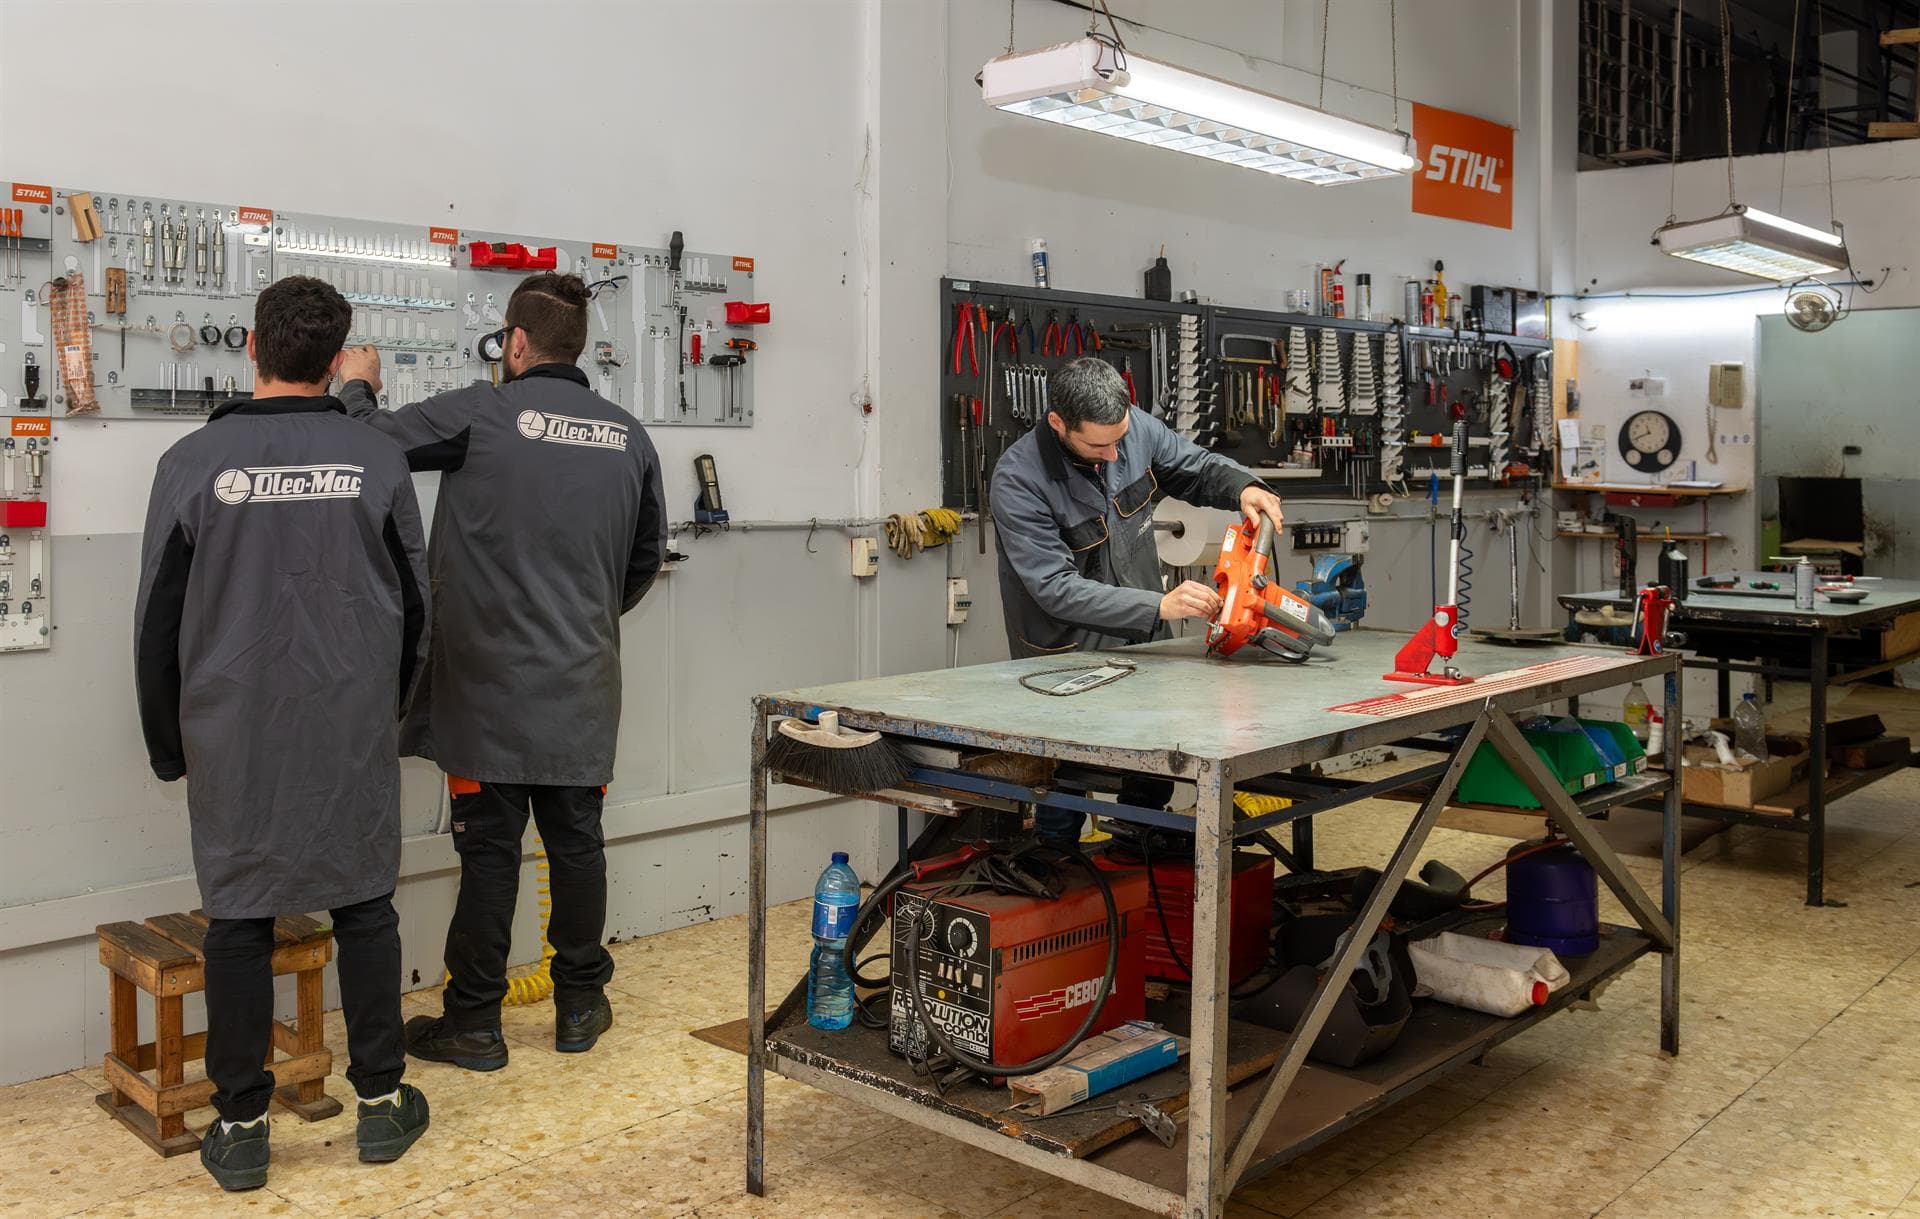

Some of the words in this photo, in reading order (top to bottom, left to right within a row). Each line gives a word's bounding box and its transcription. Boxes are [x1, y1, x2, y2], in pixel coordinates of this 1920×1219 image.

[1425, 144, 1502, 193] STIHL
[15, 188, 48, 198] STIHL
[242, 211, 268, 220] STIHL
[432, 231, 455, 240] STIHL
[594, 247, 615, 255] STIHL
[15, 422, 47, 431] STIHL
[546, 419, 628, 446] Oleo-Mac
[253, 470, 362, 496] Oleo-Mac
[892, 989, 990, 1035] REOLUTION
[942, 1022, 990, 1047] combi
